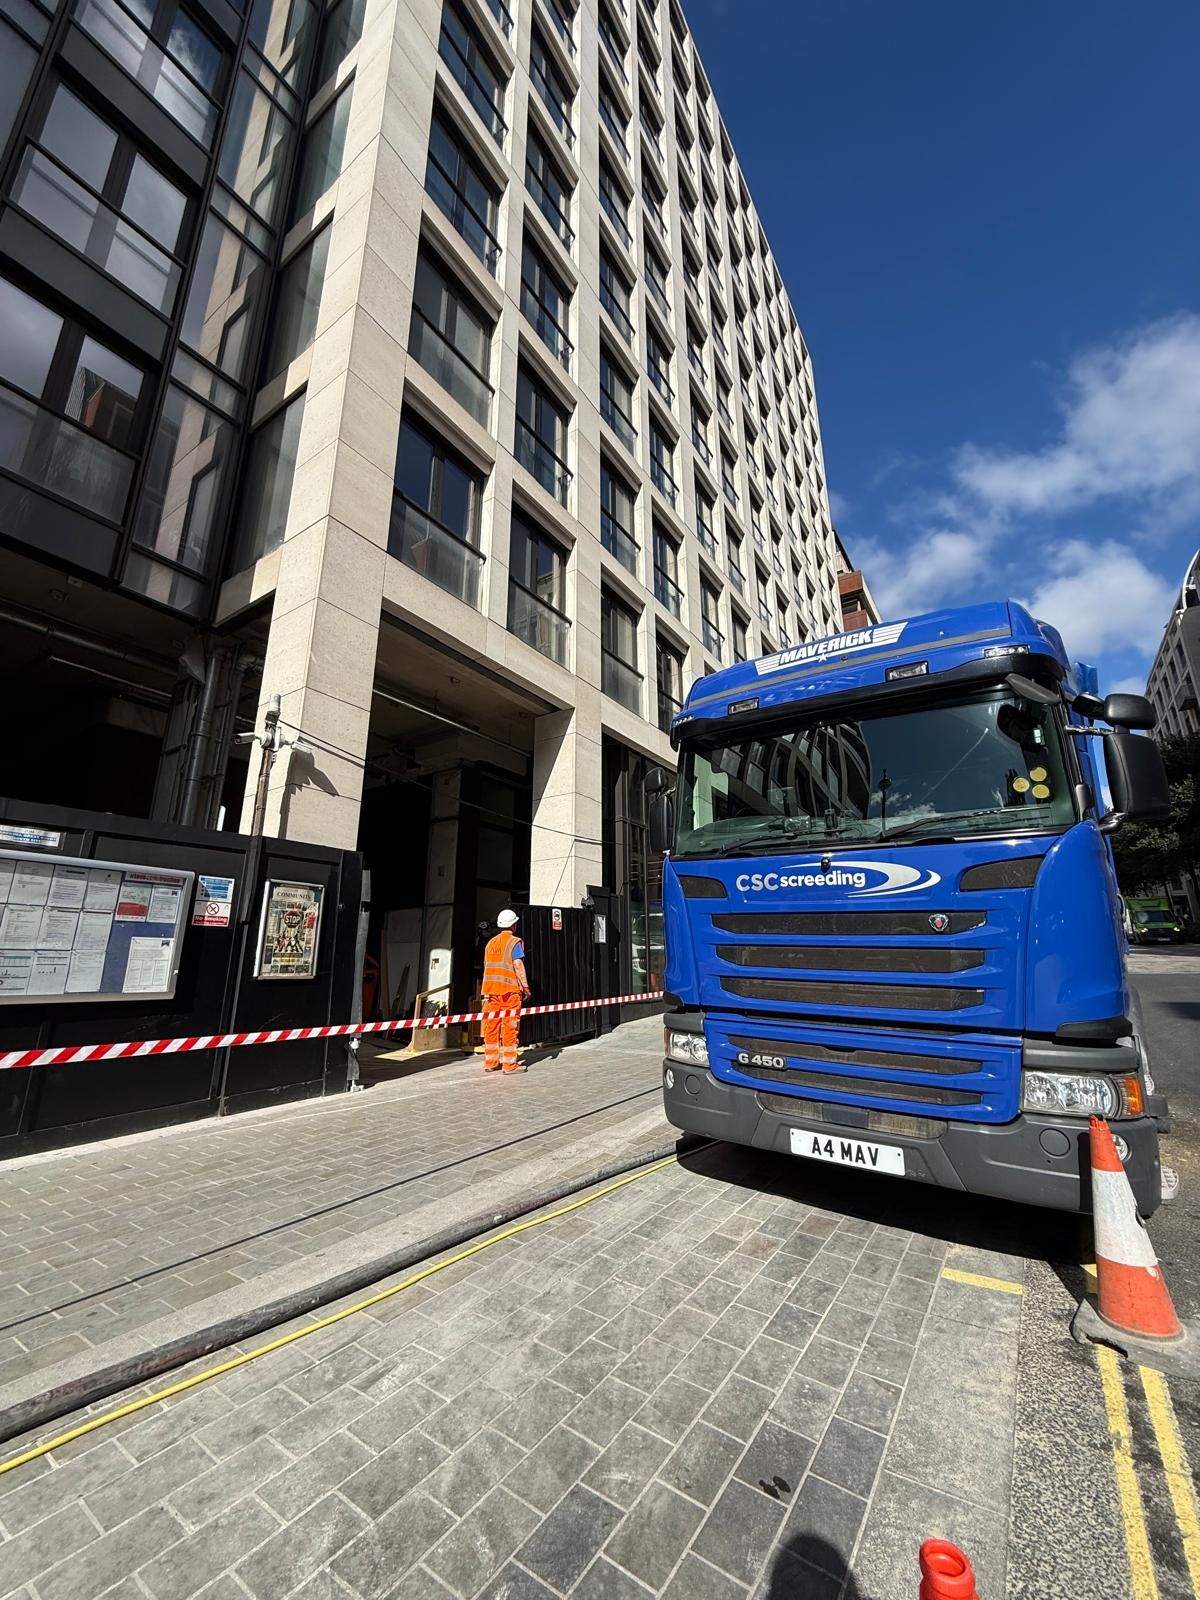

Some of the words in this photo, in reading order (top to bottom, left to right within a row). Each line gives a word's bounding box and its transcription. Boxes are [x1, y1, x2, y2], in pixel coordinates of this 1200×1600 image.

[779, 630, 873, 665] MAVERICK
[277, 891, 312, 900] COMMUNITY
[285, 915, 301, 924] STOP
[738, 1053, 749, 1064] G
[751, 1055, 784, 1068] 450
[811, 1136, 834, 1158] A4
[840, 1141, 879, 1167] MAV
